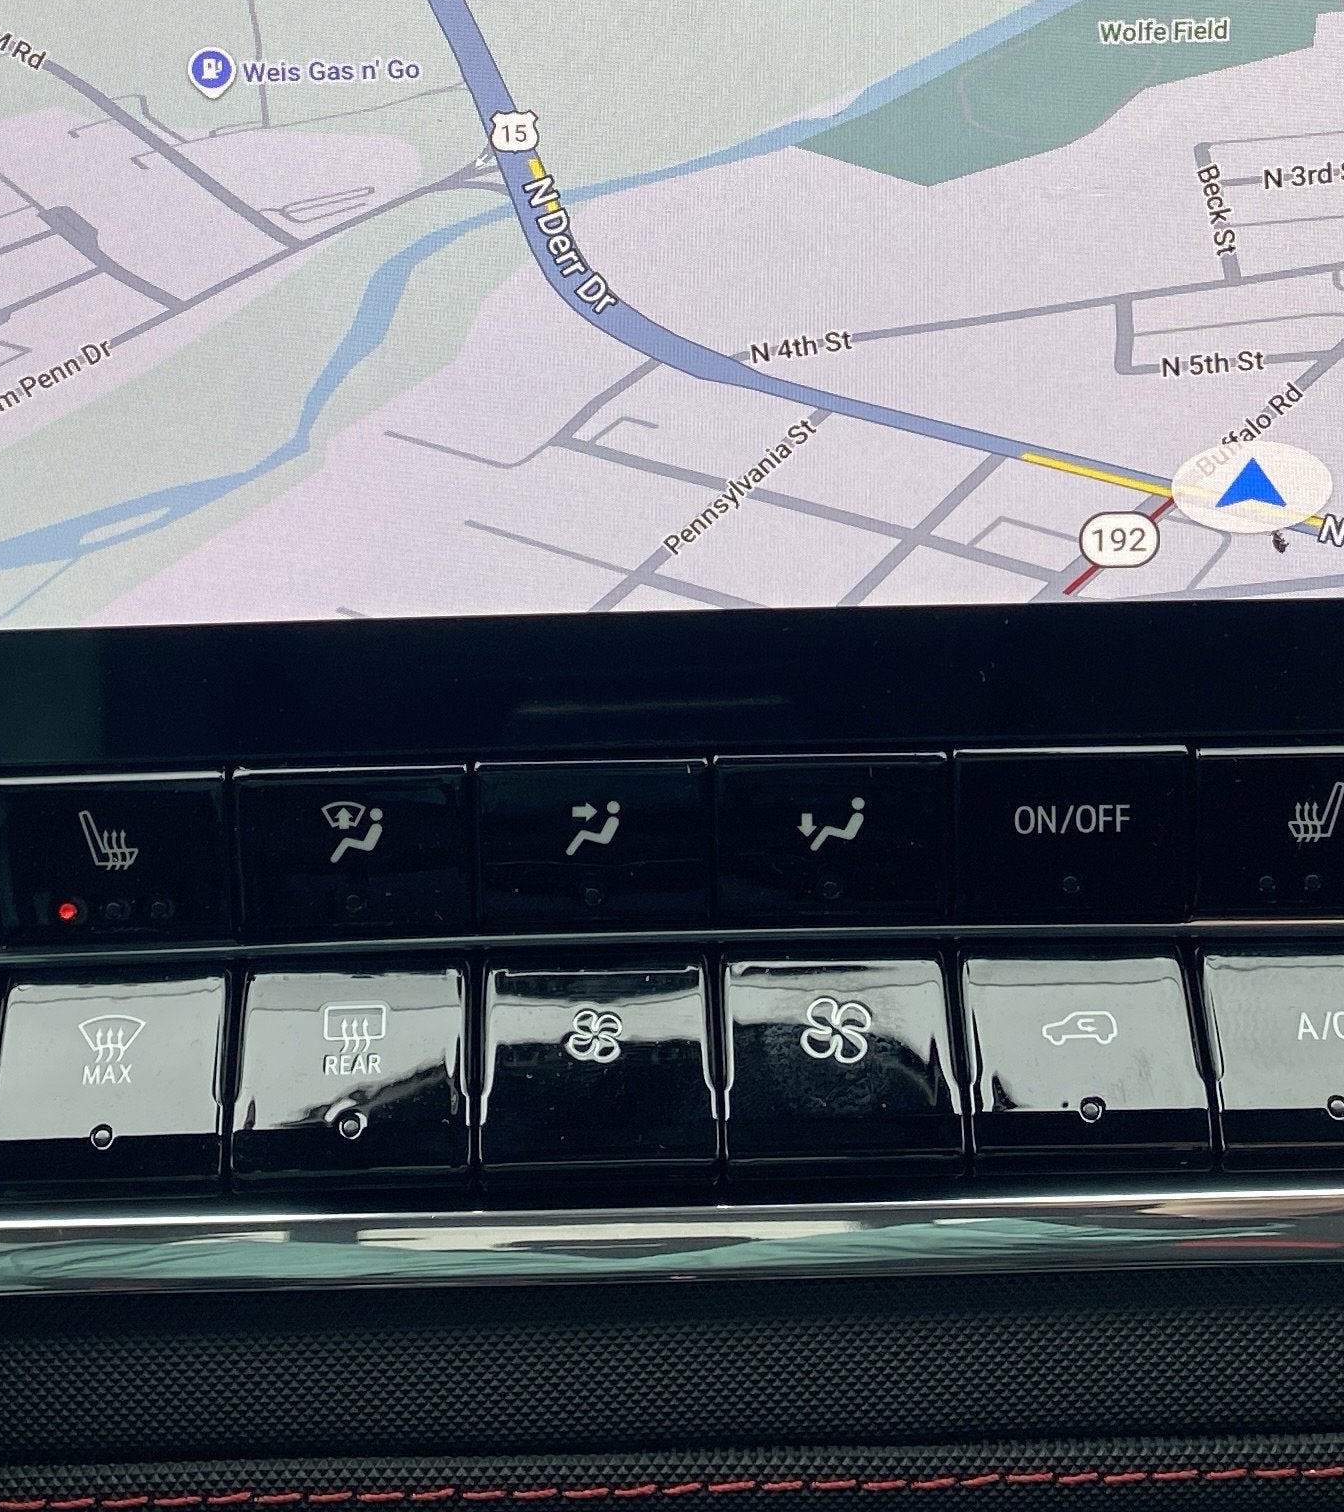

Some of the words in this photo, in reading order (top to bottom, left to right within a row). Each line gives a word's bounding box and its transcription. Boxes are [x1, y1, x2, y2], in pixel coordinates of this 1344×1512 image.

[1099, 21, 1166, 42] Wolfe
[1174, 19, 1229, 41] Field
[12, 40, 46, 70] Rd
[243, 61, 301, 83] Weis
[309, 61, 355, 82] Gas
[387, 59, 420, 80] Go
[501, 124, 527, 144] 15
[525, 175, 560, 207] N
[1263, 168, 1283, 189] N
[1290, 163, 1333, 186] 3rd
[1196, 166, 1231, 225] Beck
[1214, 227, 1237, 257] St
[537, 208, 586, 277] Derr
[575, 274, 617, 315] Dr
[750, 343, 771, 364] N
[778, 336, 818, 361] 4th
[824, 331, 853, 352] St
[20, 358, 82, 403] Penn
[81, 338, 113, 368] Dr
[1161, 358, 1180, 378] N
[1190, 353, 1229, 375] 5th
[1237, 351, 1264, 371] St
[1268, 382, 1304, 415] Rd
[663, 448, 792, 555] Pennsylvania
[788, 420, 817, 445] St
[1092, 528, 1147, 553] 192
[1014, 803, 1131, 835] ON/OFF
[82, 1063, 133, 1085] MAX
[324, 1053, 382, 1076] REAR
